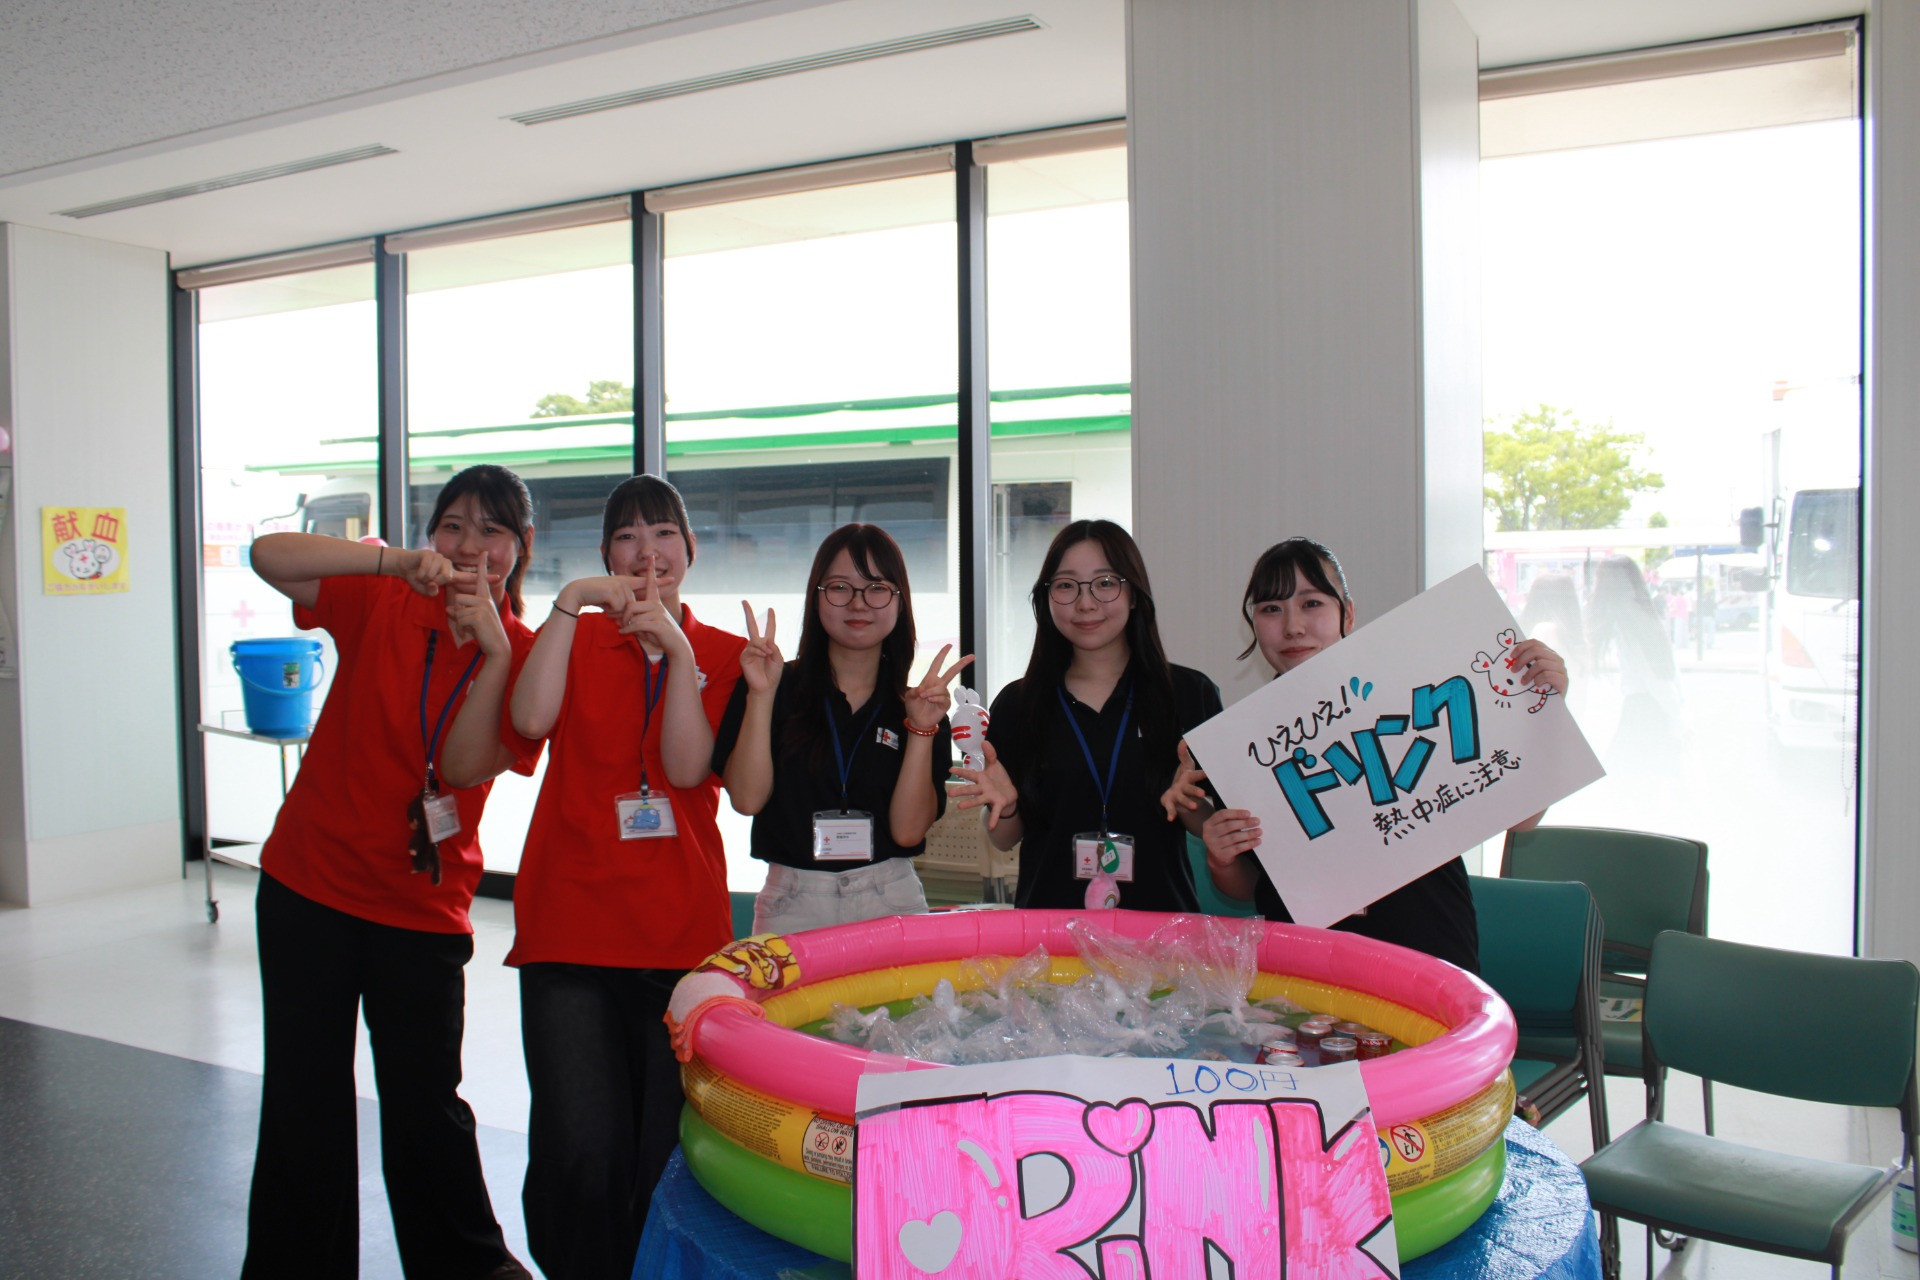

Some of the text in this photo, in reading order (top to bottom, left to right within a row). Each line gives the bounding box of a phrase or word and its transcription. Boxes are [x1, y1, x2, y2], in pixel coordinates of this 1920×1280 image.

[51, 510, 119, 543] 献血
[1271, 675, 1481, 841] ドリンク
[1373, 749, 1521, 846] 熱中症に注意
[1165, 1062, 1299, 1096] 100円
